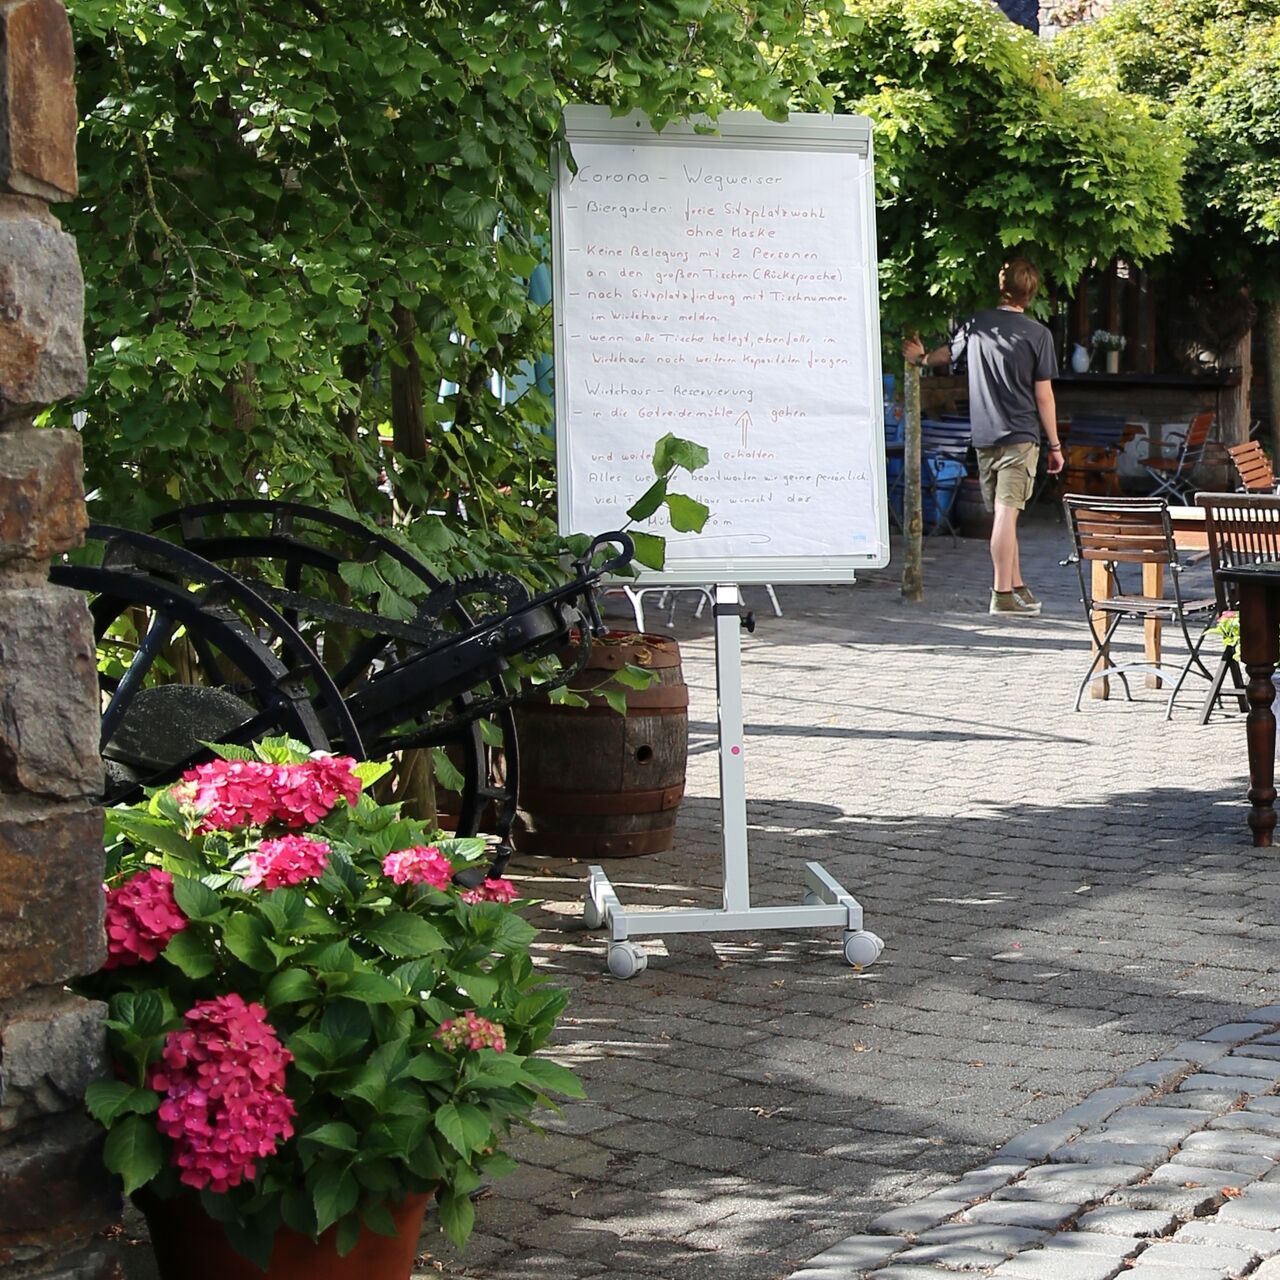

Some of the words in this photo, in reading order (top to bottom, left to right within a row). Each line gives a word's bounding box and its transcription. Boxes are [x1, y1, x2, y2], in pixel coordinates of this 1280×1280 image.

[578, 165, 649, 183] Corona
[683, 164, 783, 191] Wegweiser
[587, 200, 672, 218] Biergarten:
[685, 197, 715, 221] freie
[724, 202, 825, 224] Sitzplatzwahl
[686, 224, 724, 237] ohne
[731, 226, 776, 238] Maske
[587, 245, 622, 256] Keine
[631, 246, 688, 263] Belegung
[699, 248, 720, 258] mit
[732, 247, 741, 259] 2
[753, 247, 818, 260] Personen
[587, 270, 606, 278] an
[620, 268, 643, 278] den
[656, 268, 699, 284] großen
[702, 269, 749, 280] Tischen
[588, 288, 622, 299] nach
[632, 288, 735, 306] Sitzplatzfindung
[743, 290, 764, 301] mit
[770, 291, 848, 302] Tischnummer
[592, 312, 605, 321] im
[611, 310, 669, 321] Wirtshaus
[635, 333, 655, 343] alle
[660, 334, 704, 343] Tische
[823, 335, 836, 343] im
[592, 352, 646, 364] Wirtshaus
[696, 353, 737, 364] weiteren
[585, 379, 651, 396] Wirtshaus
[673, 384, 753, 403] Reservierung
[592, 408, 602, 417] in
[611, 408, 628, 417] die
[638, 406, 733, 418] Getreidemühle
[771, 406, 807, 423] gehen
[591, 451, 613, 461] und
[723, 449, 775, 460] erhalten
[588, 471, 622, 482] Alles
[691, 470, 757, 482] beantworten
[784, 475, 812, 486] gerne
[787, 493, 812, 503] das
